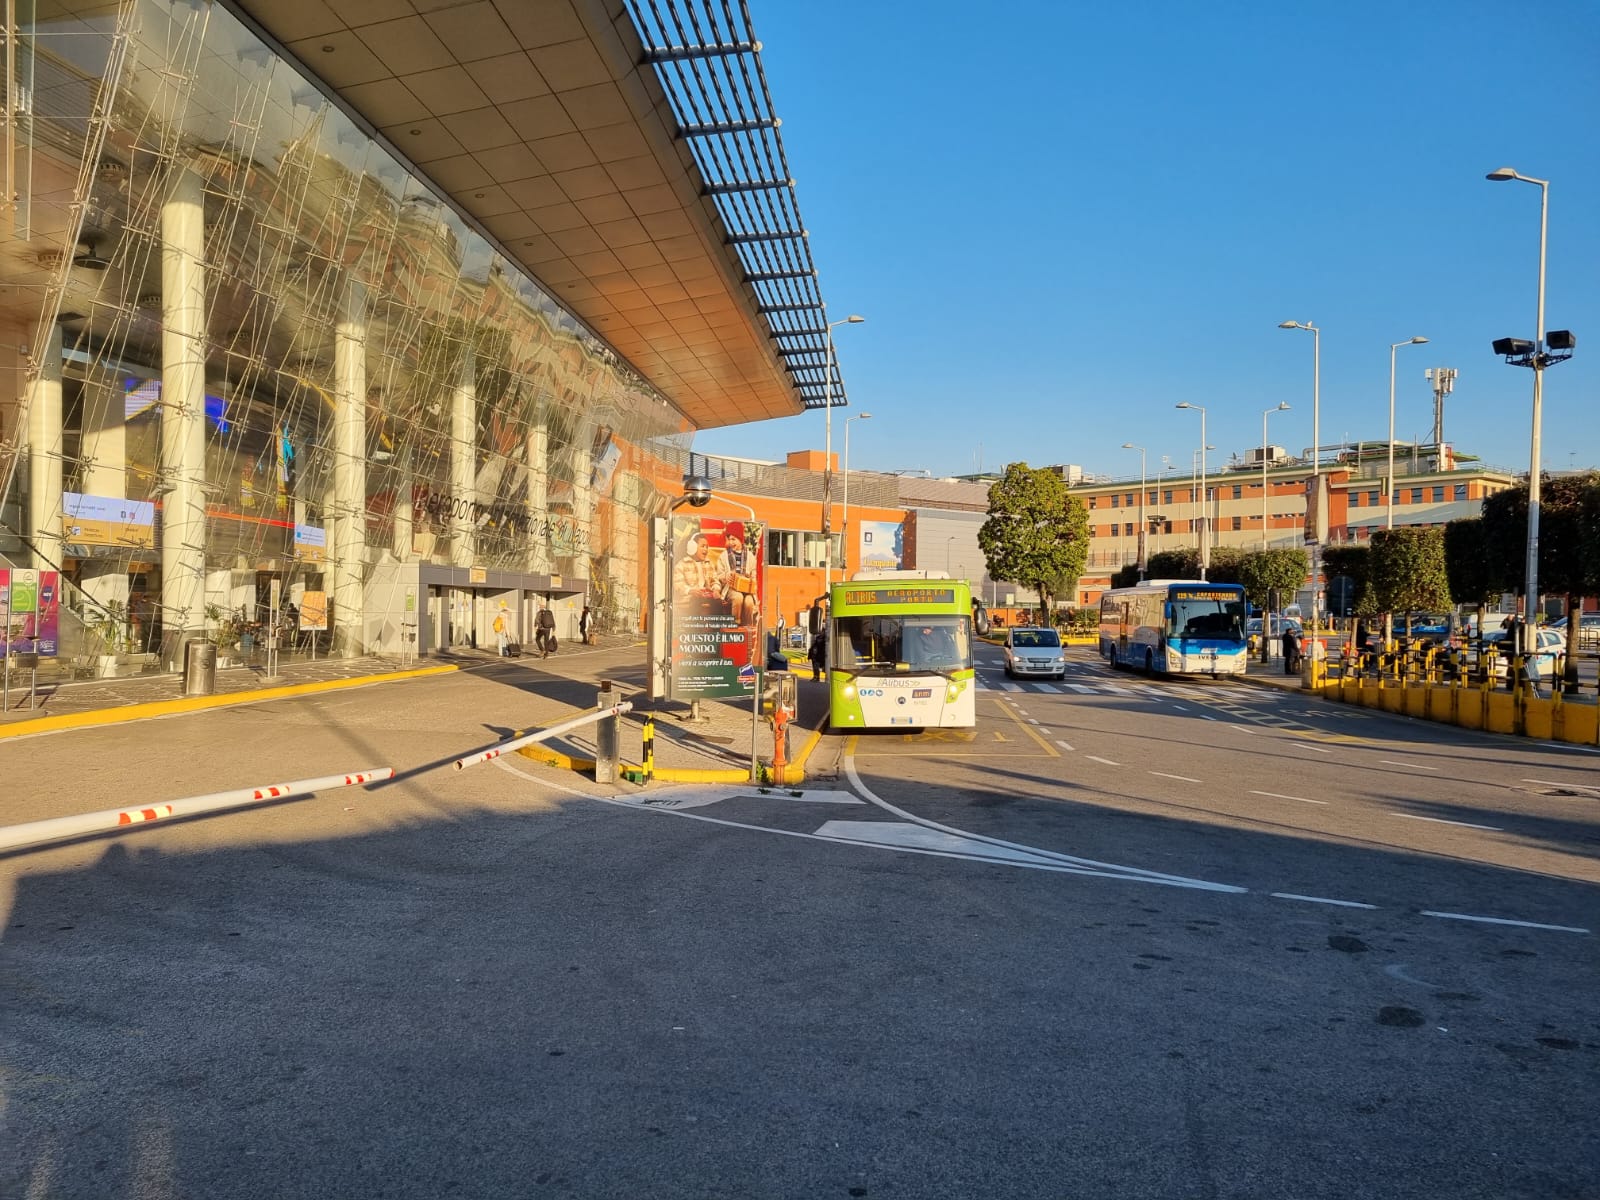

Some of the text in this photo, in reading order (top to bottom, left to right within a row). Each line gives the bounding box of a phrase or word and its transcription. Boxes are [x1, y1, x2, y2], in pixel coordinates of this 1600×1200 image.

[846, 589, 945, 603] ALIBUS AEROPORTO
[680, 633, 714, 643] QUESTO
[715, 631, 721, 643] È
[728, 633, 744, 642] MIO
[882, 678, 910, 688] Alibus
